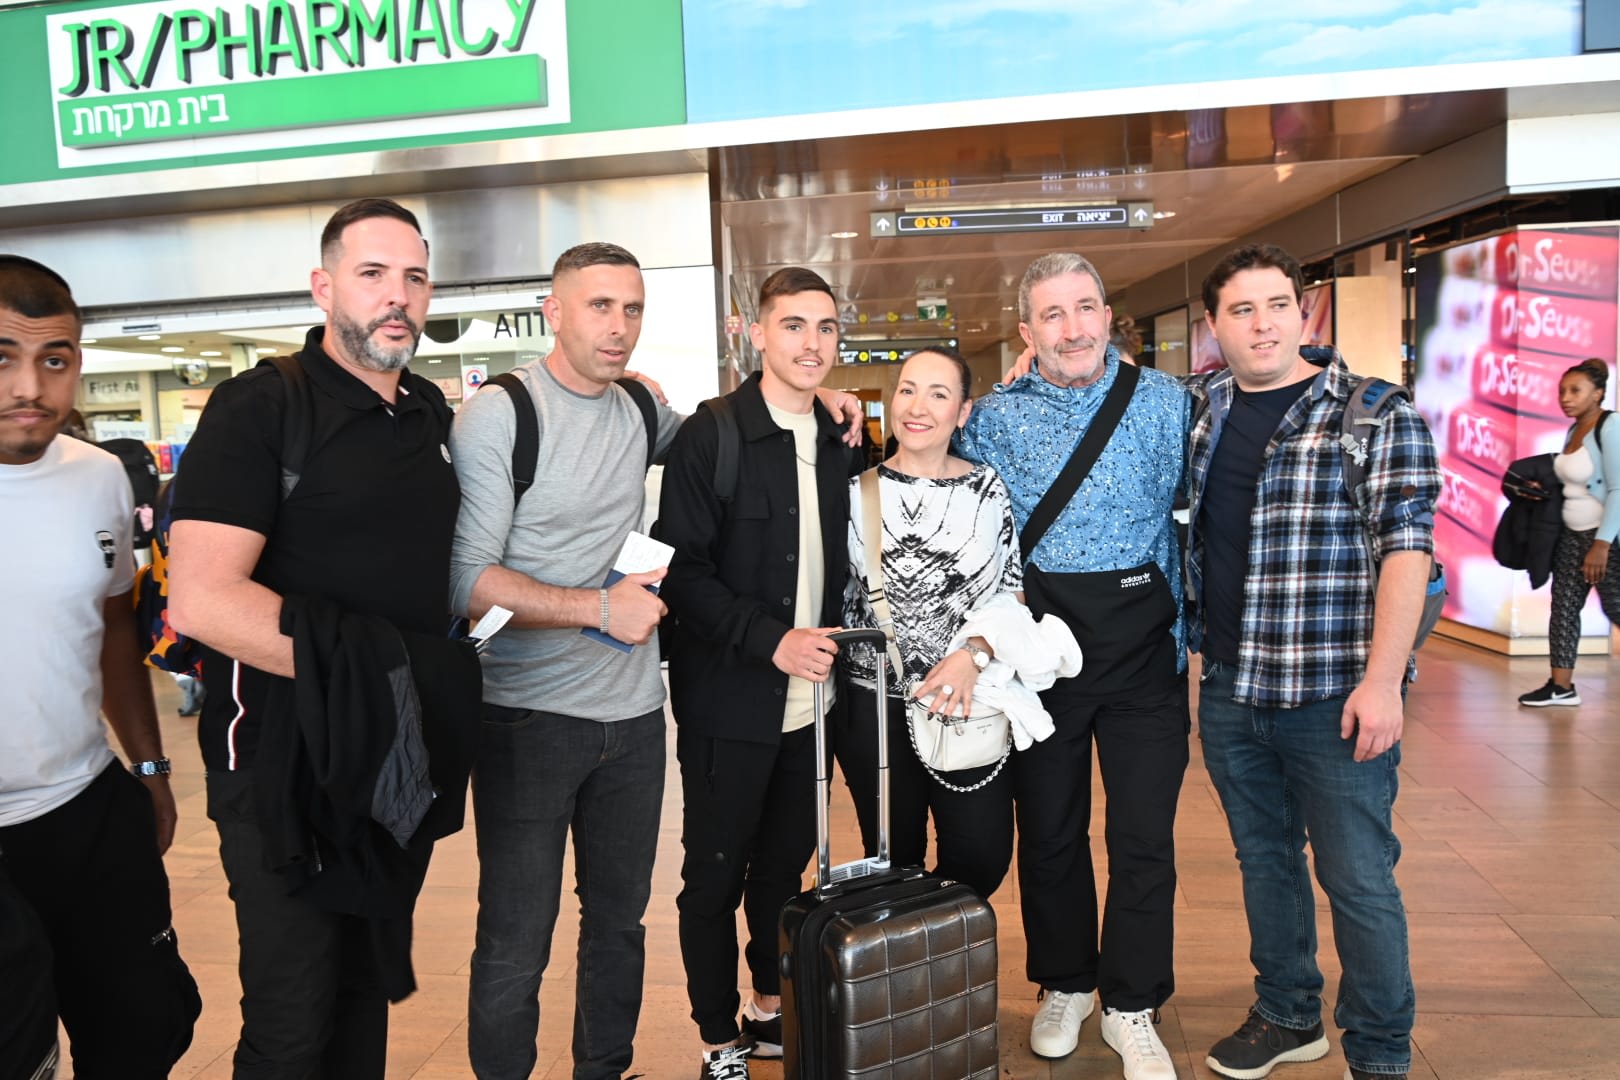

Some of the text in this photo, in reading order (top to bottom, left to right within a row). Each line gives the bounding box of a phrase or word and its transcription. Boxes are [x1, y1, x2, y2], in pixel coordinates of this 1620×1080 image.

[58, 0, 537, 97] JR/PHARMACY
[72, 93, 230, 138] בית מרקחת
[1042, 213, 1064, 223] EXIT
[1076, 211, 1111, 222] יציאה
[89, 381, 119, 394] First
[1120, 576, 1143, 584] adidas
